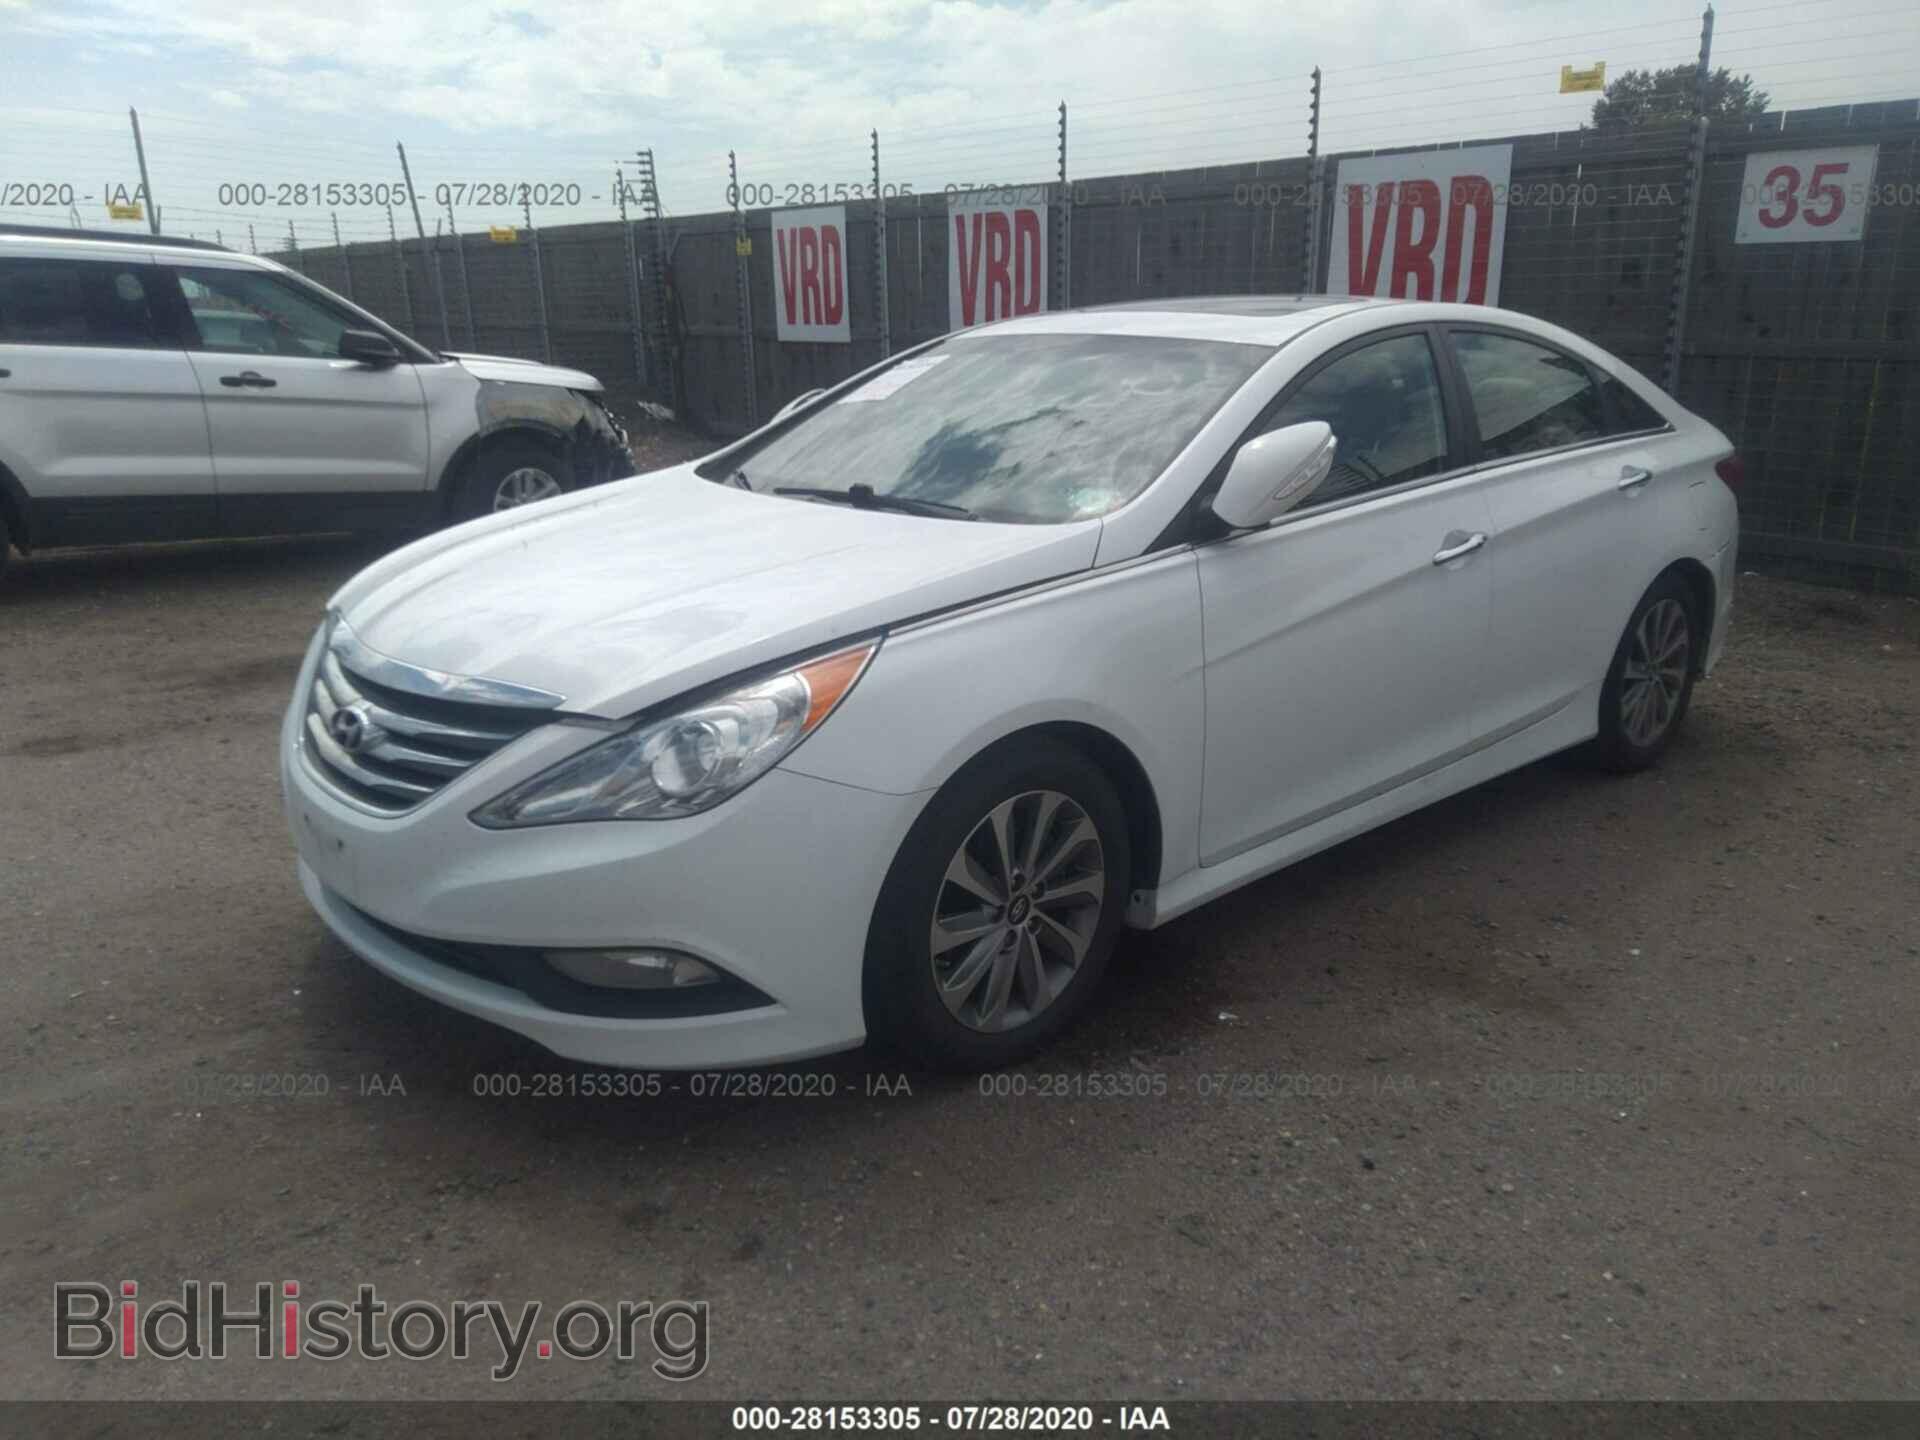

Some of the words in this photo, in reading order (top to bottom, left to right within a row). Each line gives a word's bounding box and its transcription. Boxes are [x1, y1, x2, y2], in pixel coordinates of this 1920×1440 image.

[1347, 174, 1495, 306] VRD
[1758, 162, 1850, 229] 35
[777, 224, 843, 326] VRD
[955, 209, 1041, 326] VRD
